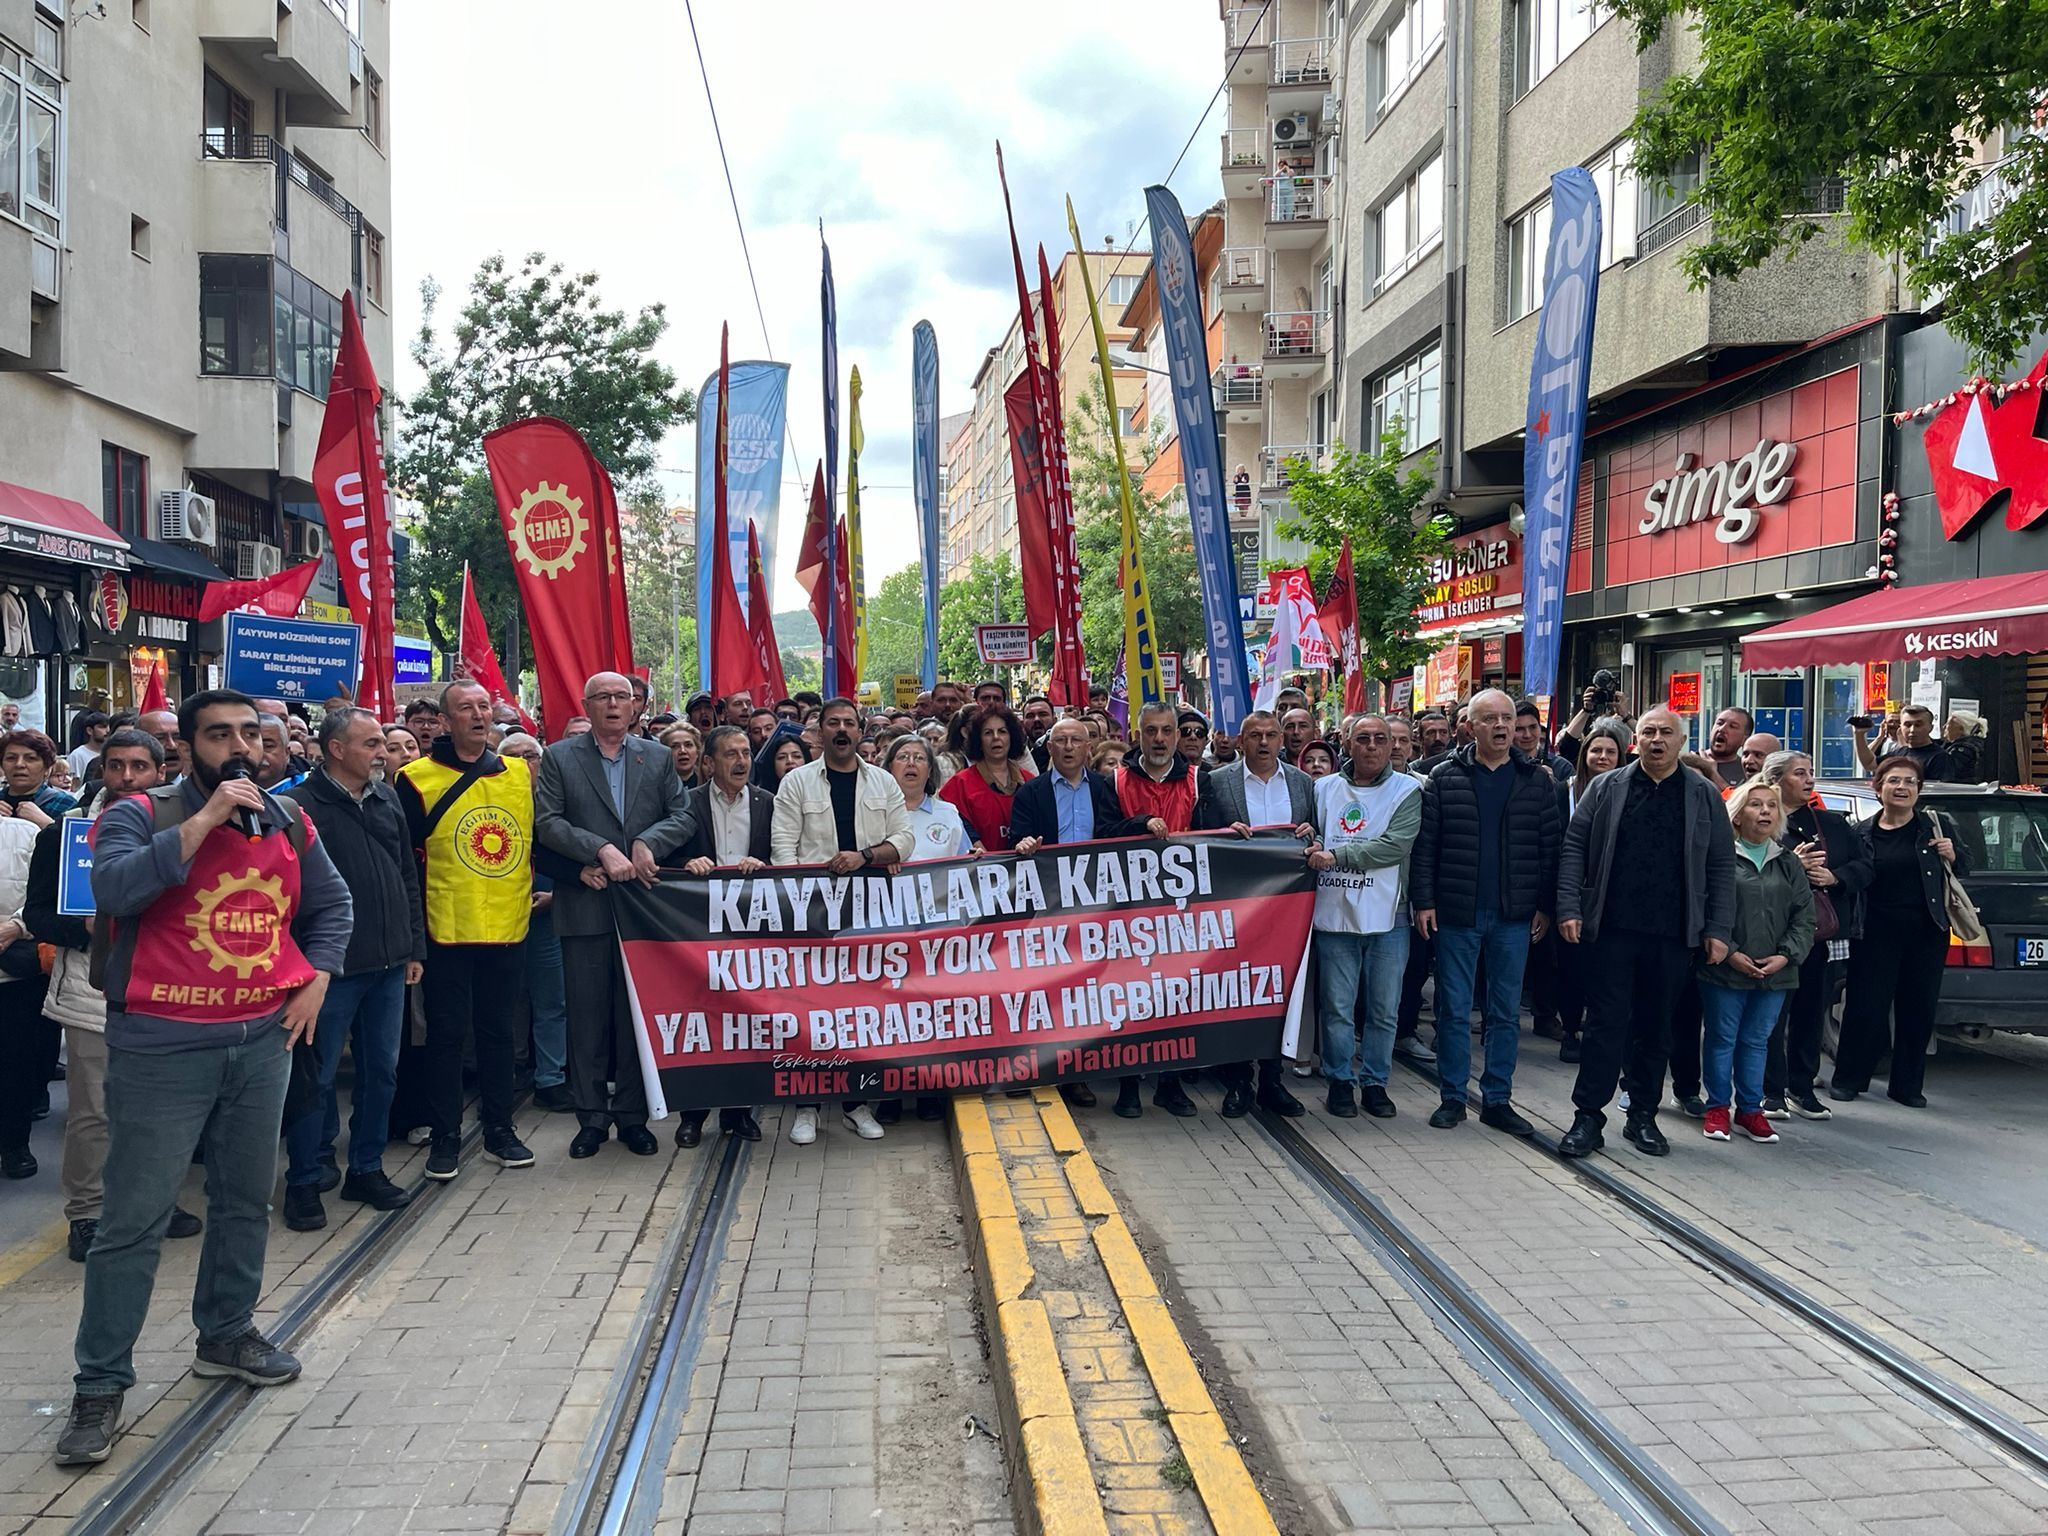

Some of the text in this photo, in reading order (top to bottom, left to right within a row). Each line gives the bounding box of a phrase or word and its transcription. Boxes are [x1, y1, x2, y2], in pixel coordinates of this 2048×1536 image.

[1638, 438, 1797, 544] simge
[37, 533, 69, 557] ADRES
[69, 539, 92, 560] GYM
[1456, 540, 1509, 578] DÖNER
[1457, 574, 1493, 597] SOSLU
[1447, 596, 1492, 618] İSKENDER
[237, 627, 351, 646] KAYYUM DÜZENİNE SON!
[1927, 628, 1998, 651] KESKİN
[239, 650, 347, 667] SARAY REJİMİNE KARŞI
[263, 662, 322, 676] BİRLEŞELİM!
[276, 679, 306, 692] SOL
[460, 812, 498, 836] EĞİTİM
[709, 843, 1213, 934] KAYYIMLARA KARŞI
[707, 908, 1236, 991] KURTULUŞ YOK TEK BAŞINA!
[2027, 941, 2044, 959] 26
[151, 983, 226, 1006] EMEK
[654, 961, 1284, 1054] YA HEP BERABER! YA HİÇBİRİMİZ!
[771, 1053, 854, 1069] Eskişehir
[774, 1036, 1196, 1096] EMEK Ve DEMOKRASİ Platformu
